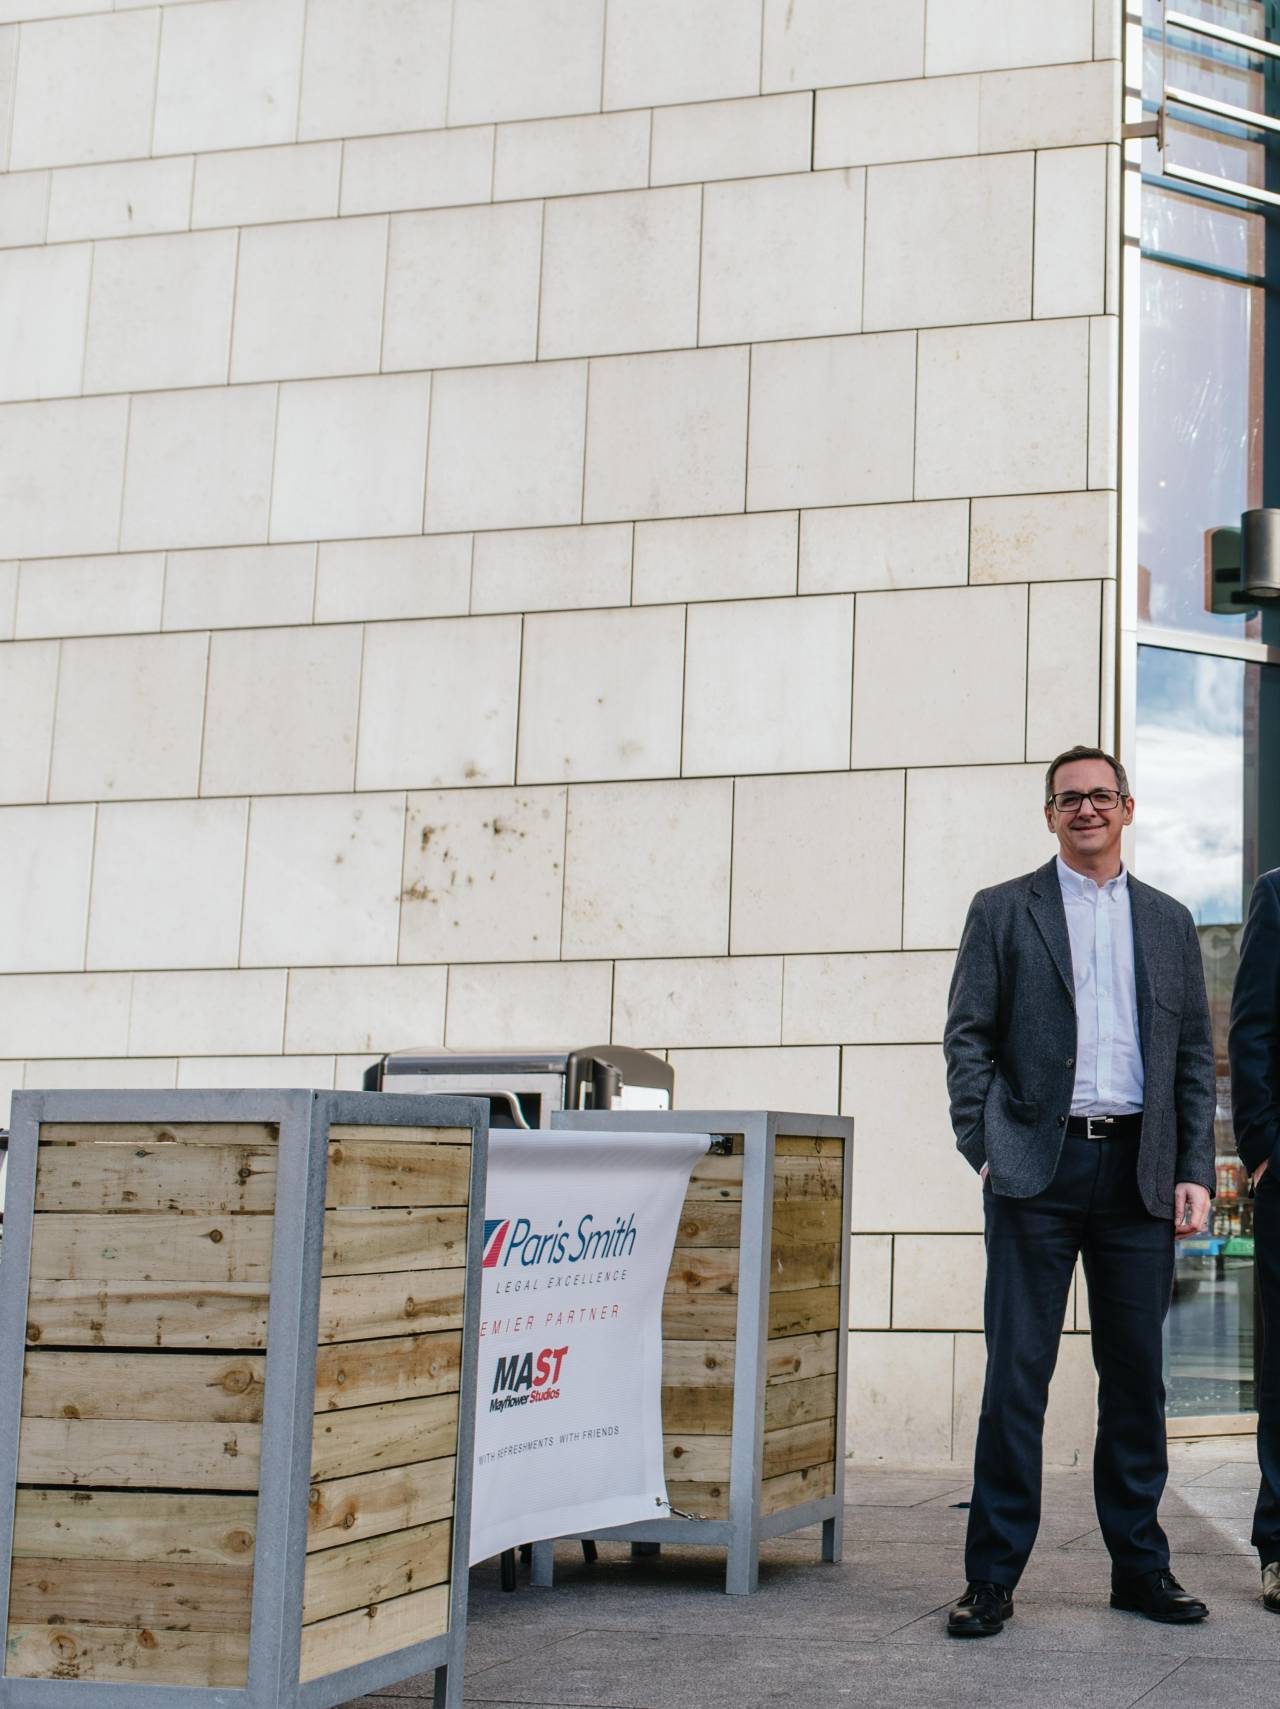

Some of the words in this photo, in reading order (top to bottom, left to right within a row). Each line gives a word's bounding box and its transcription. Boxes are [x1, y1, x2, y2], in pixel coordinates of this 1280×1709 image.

[503, 1217, 569, 1267] Paris
[568, 1211, 637, 1263] Smith
[496, 1277, 539, 1295] LEGAL
[547, 1268, 628, 1290] EXCELLENCE
[480, 1314, 535, 1338] EMIER
[545, 1304, 620, 1331] PARTNER
[492, 1345, 569, 1395] MAST
[489, 1392, 530, 1414] Mayflower
[529, 1387, 561, 1405] Studios
[559, 1432, 580, 1444] WITH
[582, 1425, 620, 1440] FRIENDS
